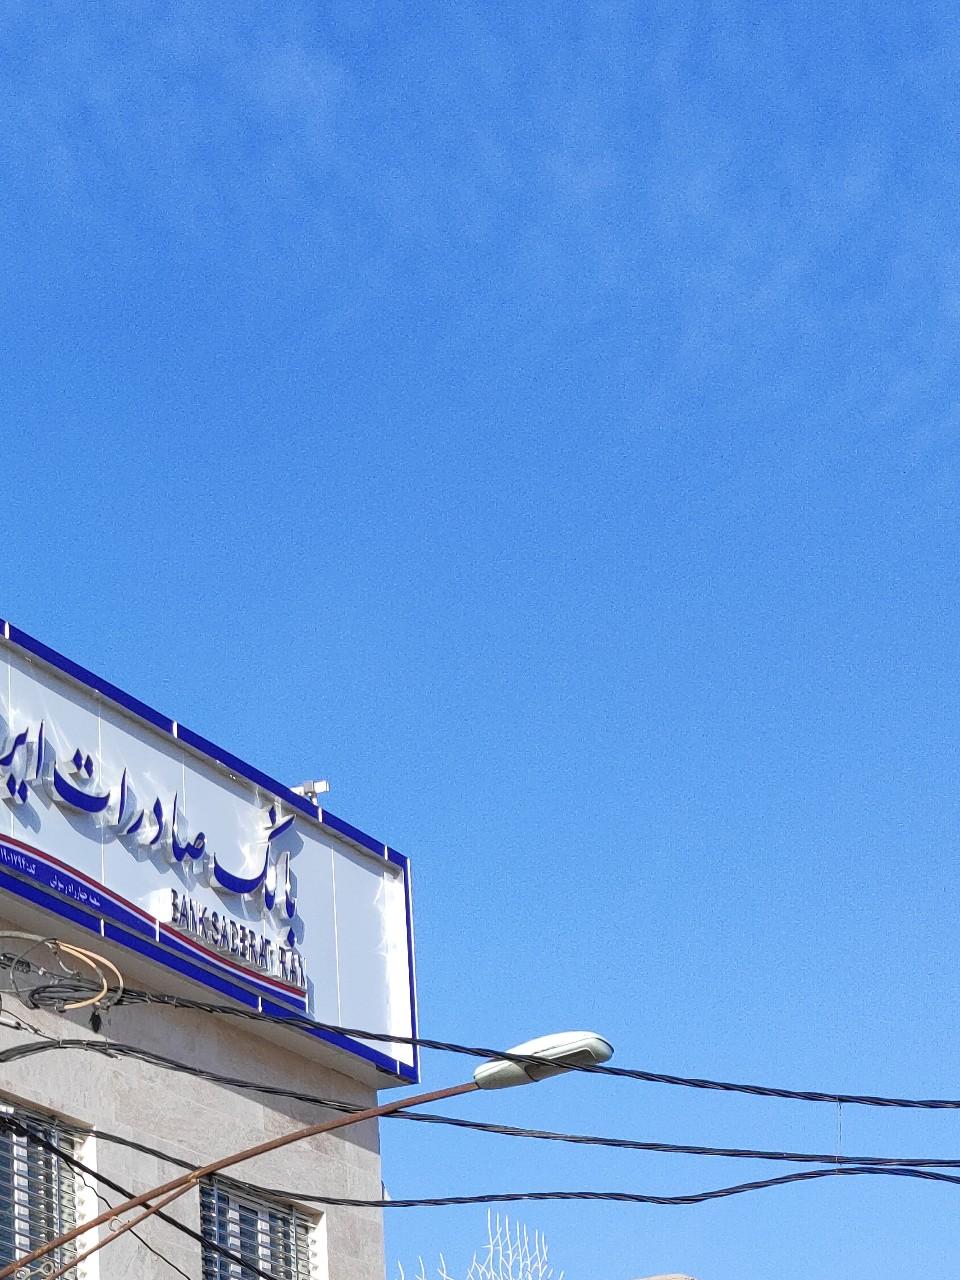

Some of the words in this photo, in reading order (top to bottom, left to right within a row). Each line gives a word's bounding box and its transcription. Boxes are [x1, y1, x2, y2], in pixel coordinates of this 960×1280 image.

[54, 747, 207, 862] صادرات
[171, 888, 208, 939] BANK
[211, 911, 271, 973] SADERAT
[213, 804, 297, 948] بانک
